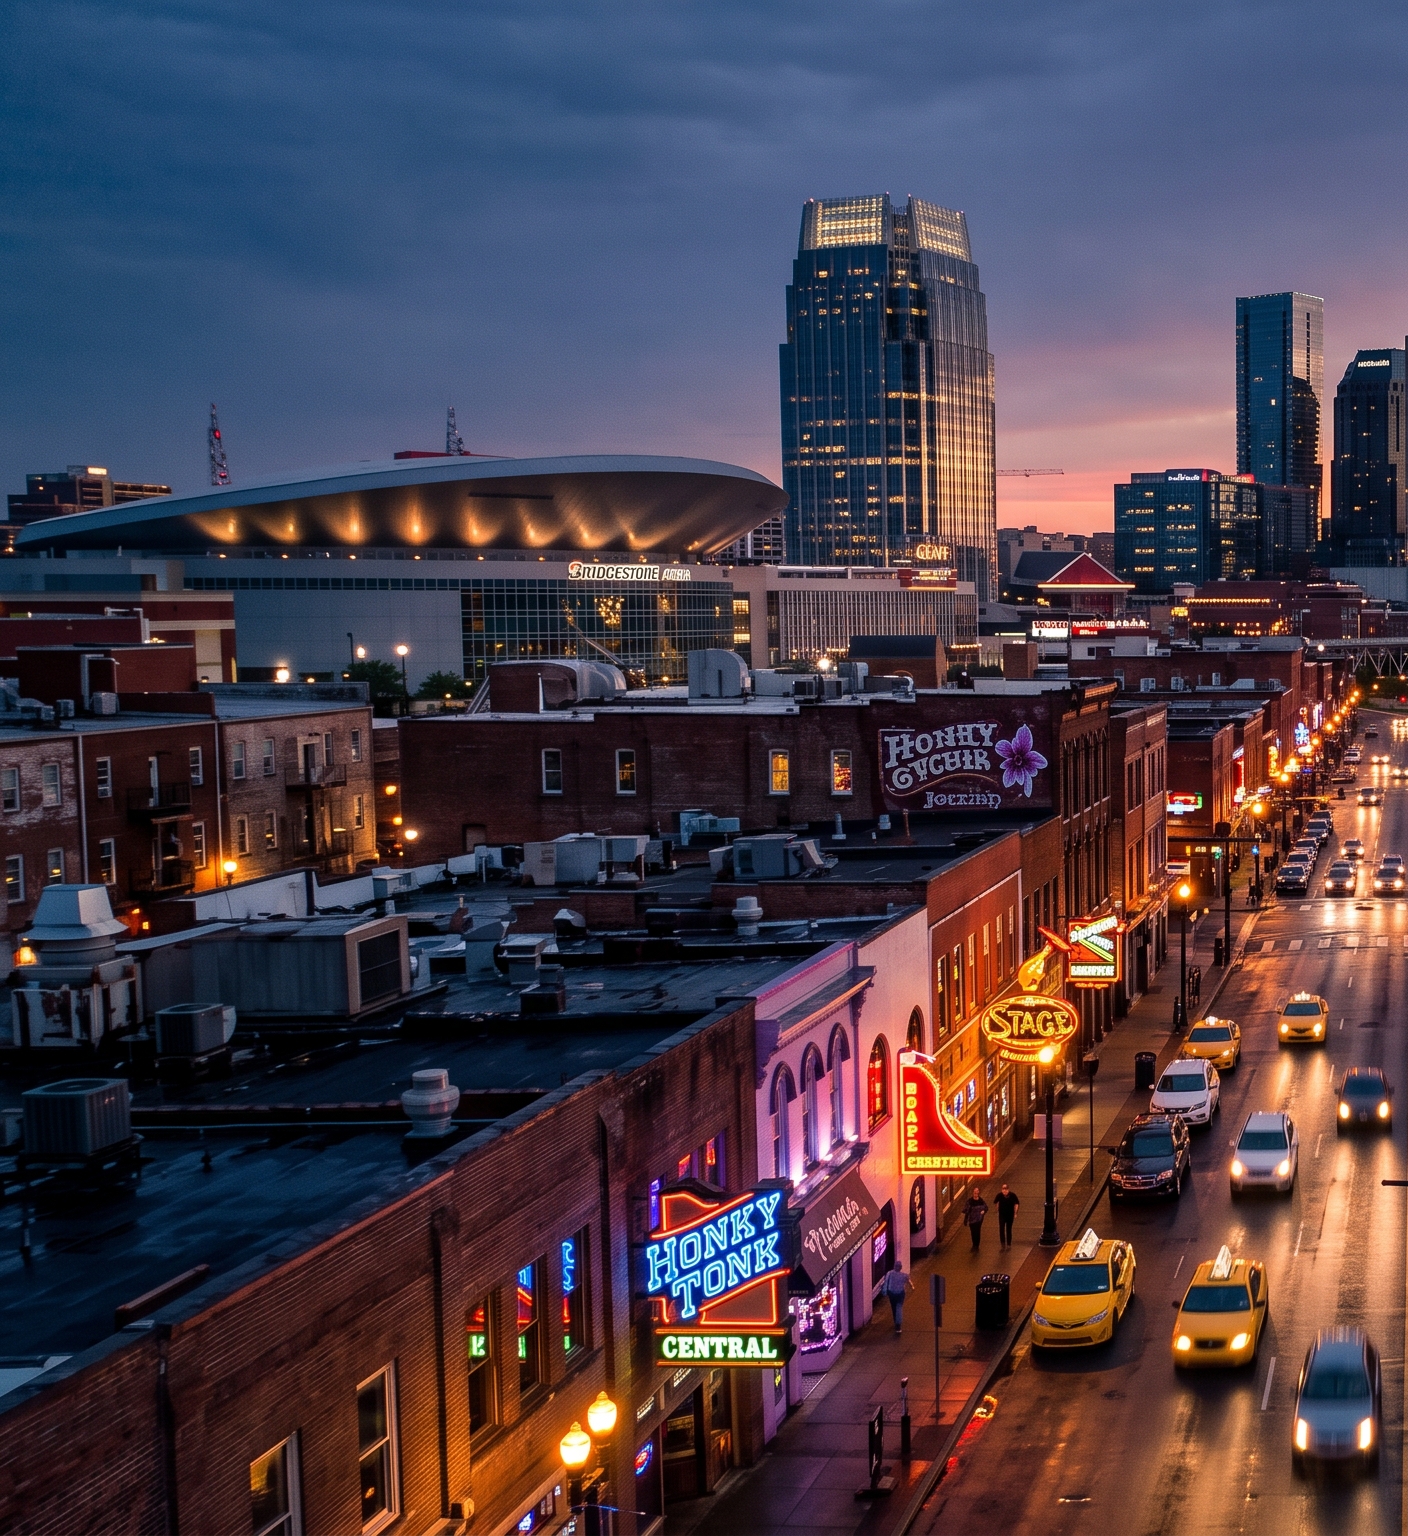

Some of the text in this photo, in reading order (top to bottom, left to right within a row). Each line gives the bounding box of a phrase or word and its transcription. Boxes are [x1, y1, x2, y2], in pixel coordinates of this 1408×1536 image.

[987, 1004, 1074, 1041] STAGE
[646, 1192, 781, 1293] HONKY
[672, 1232, 780, 1319] TONK
[662, 1336, 778, 1360] CENTRAL
